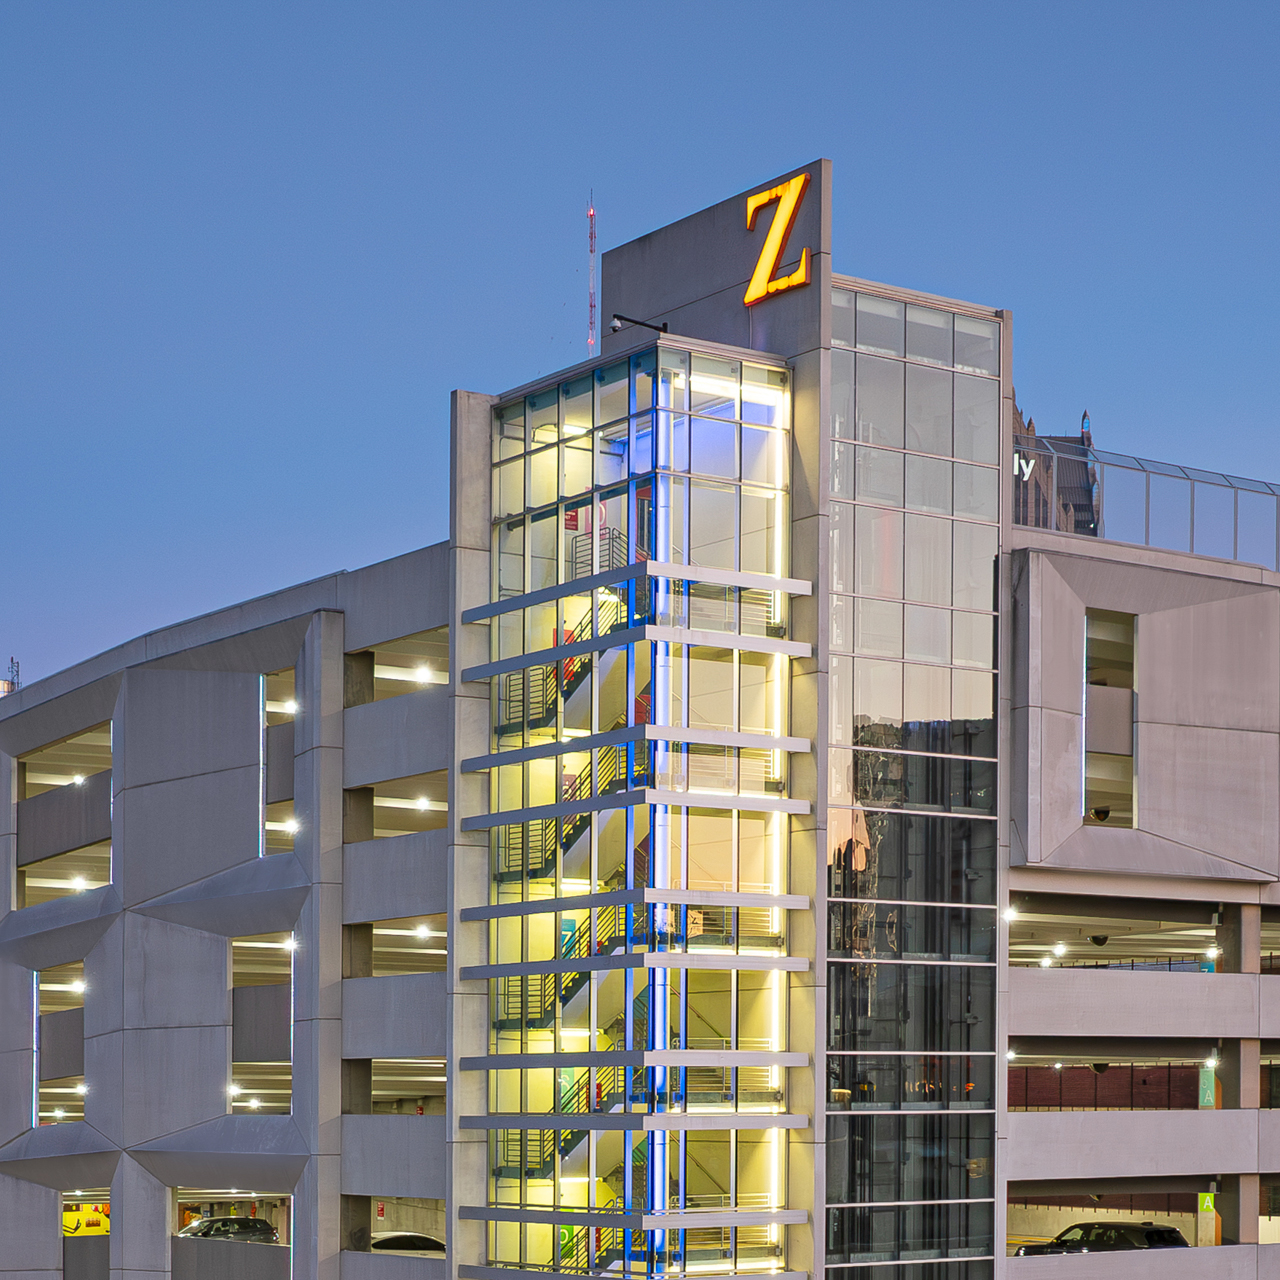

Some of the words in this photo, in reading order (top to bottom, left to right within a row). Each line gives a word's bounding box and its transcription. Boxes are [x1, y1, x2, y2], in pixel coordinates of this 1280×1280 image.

[744, 173, 811, 307] Z
[1204, 1089, 1214, 1103] A
[1203, 1195, 1214, 1210] A
